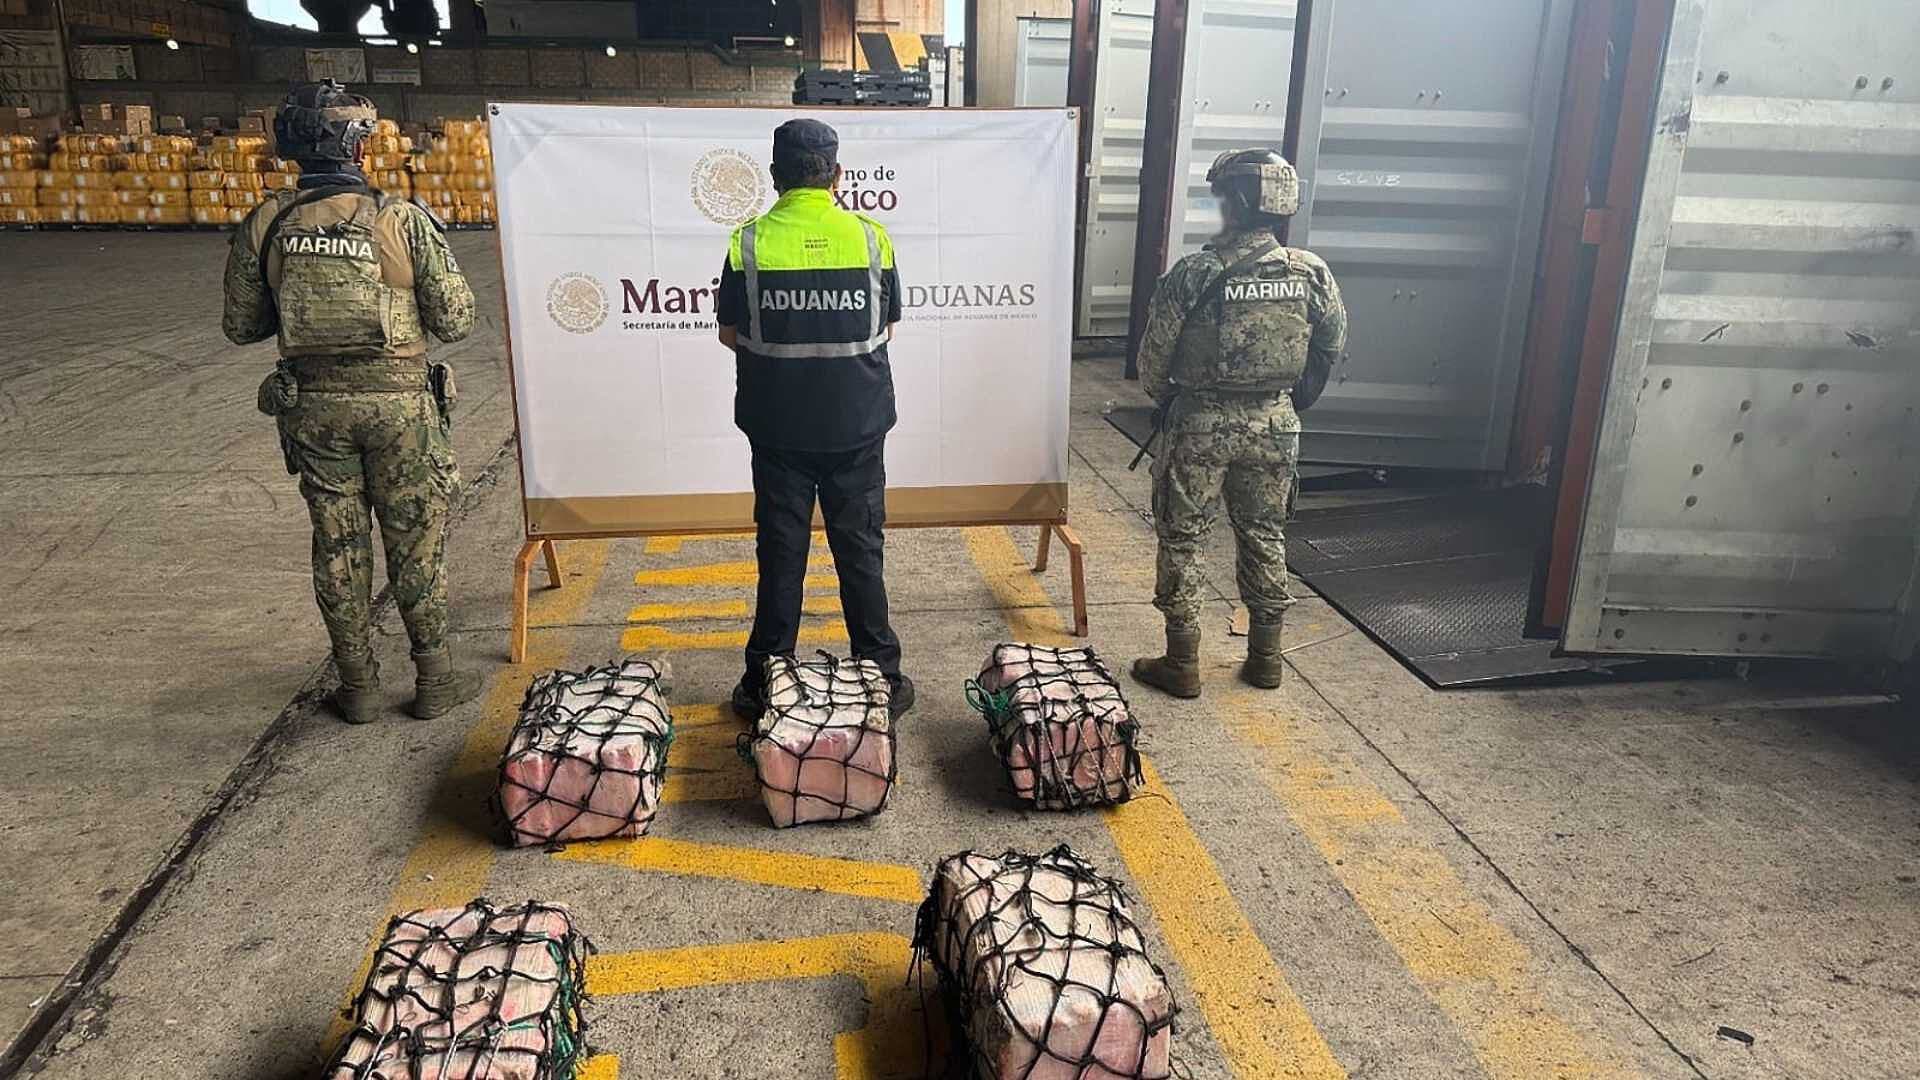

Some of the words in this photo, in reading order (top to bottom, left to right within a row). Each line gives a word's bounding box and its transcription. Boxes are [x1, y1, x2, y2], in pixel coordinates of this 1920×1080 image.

[874, 165, 896, 181] de
[833, 182, 897, 211] xico
[282, 236, 374, 260] MARINA
[620, 277, 720, 314] Mari
[761, 289, 866, 310] ADUANAS
[900, 284, 1035, 308] DUANAS
[1224, 282, 1305, 301] MARINA
[679, 321, 692, 330] de
[694, 321, 718, 329] Mari
